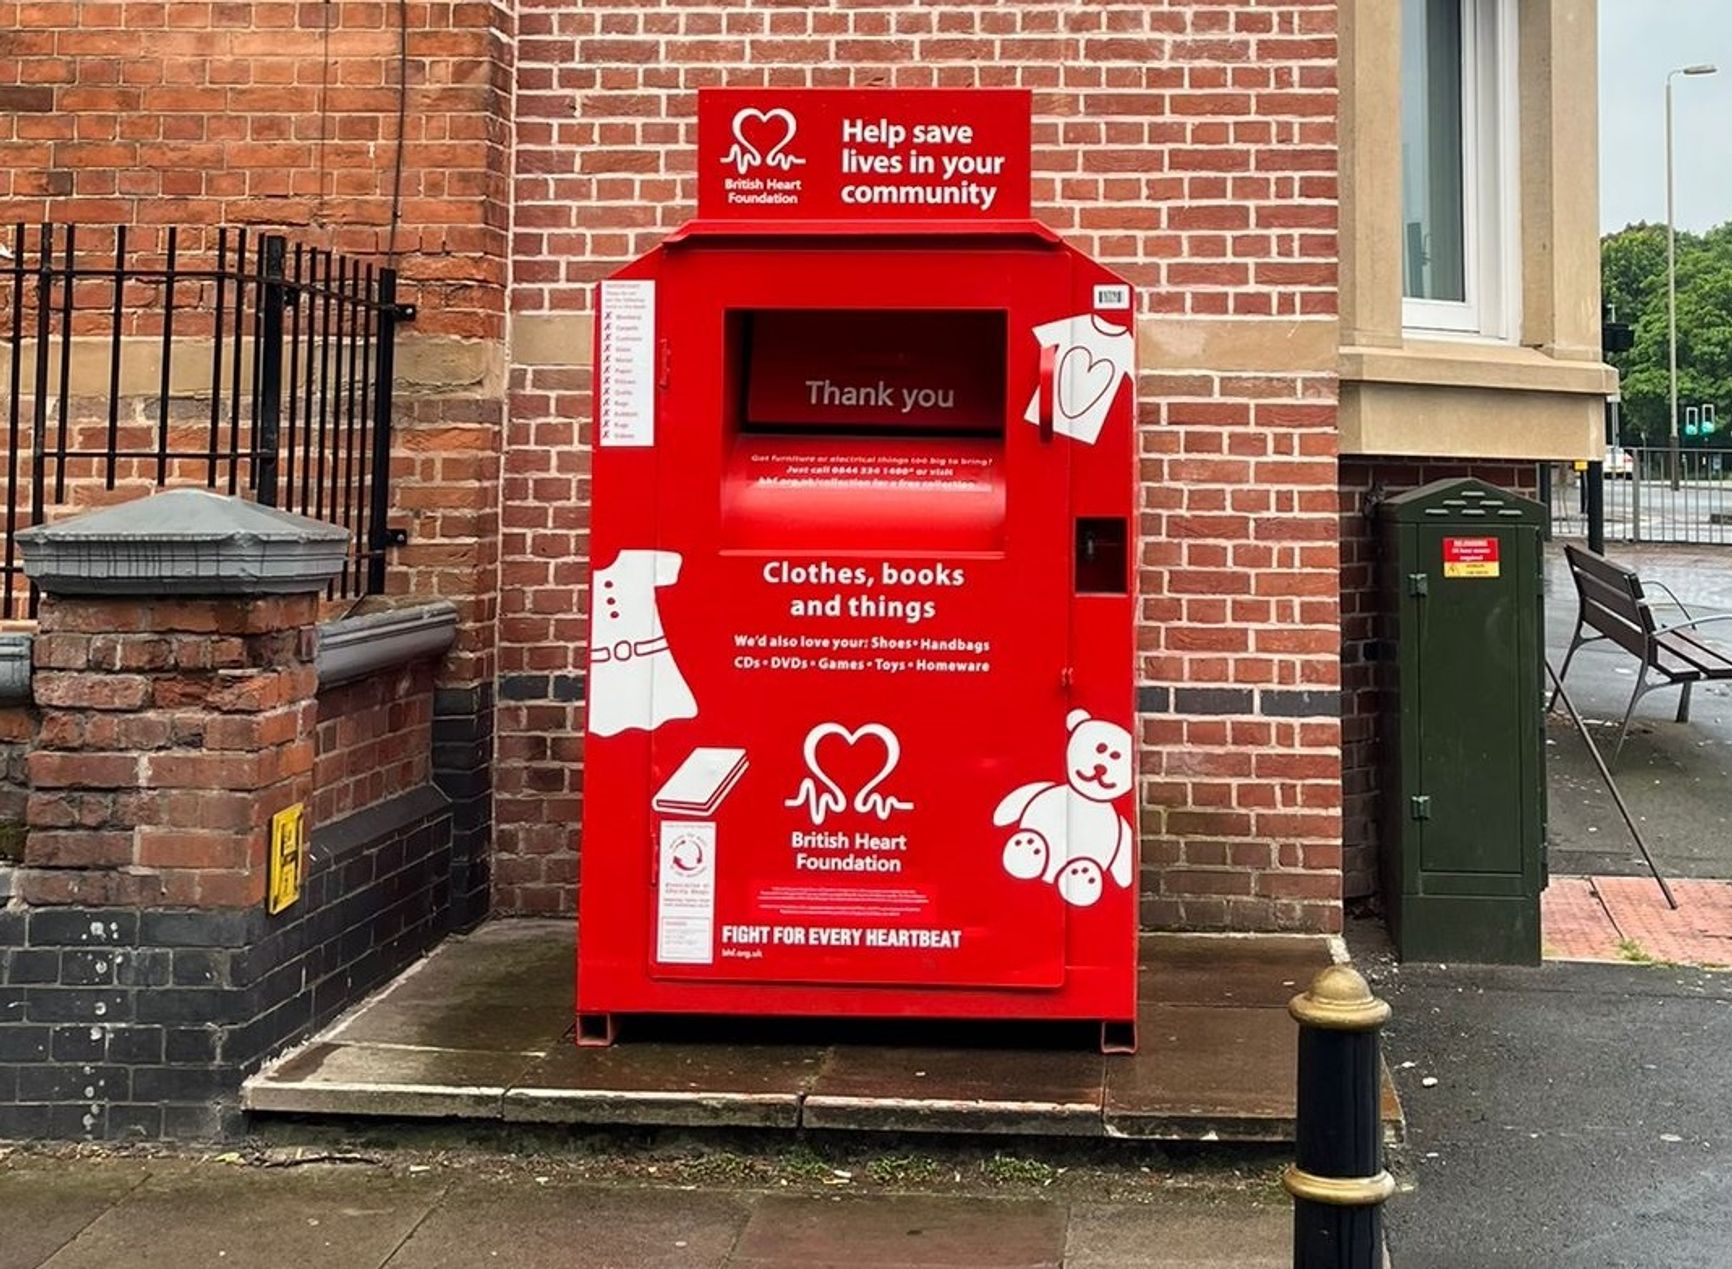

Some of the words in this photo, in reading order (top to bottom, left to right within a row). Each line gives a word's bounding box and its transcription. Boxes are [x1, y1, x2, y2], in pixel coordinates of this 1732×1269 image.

[842, 118, 906, 148] Help
[912, 125, 974, 144] save
[841, 149, 902, 173] lives
[909, 150, 934, 173] in
[941, 156, 1005, 179] your
[725, 178, 764, 190] British
[766, 178, 802, 190] Heart
[728, 192, 798, 204] Foundation
[841, 180, 996, 210] community
[805, 379, 895, 406] Thank
[901, 388, 954, 413] you
[771, 455, 816, 463] furniture
[877, 456, 909, 465] things
[930, 457, 946, 466] big
[786, 465, 809, 474] Just
[810, 466, 830, 474] call
[916, 468, 927, 476] or
[929, 468, 953, 476] visit
[763, 561, 875, 587] Clothes,
[882, 562, 965, 586] books
[790, 594, 841, 617] and
[848, 595, 936, 623] things
[734, 634, 767, 647] We'd
[769, 635, 798, 648] also
[801, 635, 830, 648] love
[832, 637, 869, 650] your:
[920, 639, 990, 653] Handbags
[734, 656, 761, 669] CDs
[771, 657, 808, 669] DVDs
[818, 658, 865, 670] Games
[875, 658, 905, 673] Toys
[916, 659, 990, 672] Homeware
[791, 831, 849, 849] British
[855, 833, 907, 850] Heart
[796, 853, 902, 872] Foundation
[722, 925, 771, 943] FIGHT
[773, 926, 806, 944] FOR
[808, 927, 863, 946] EVERY
[865, 929, 962, 948] HEARTBEAT
